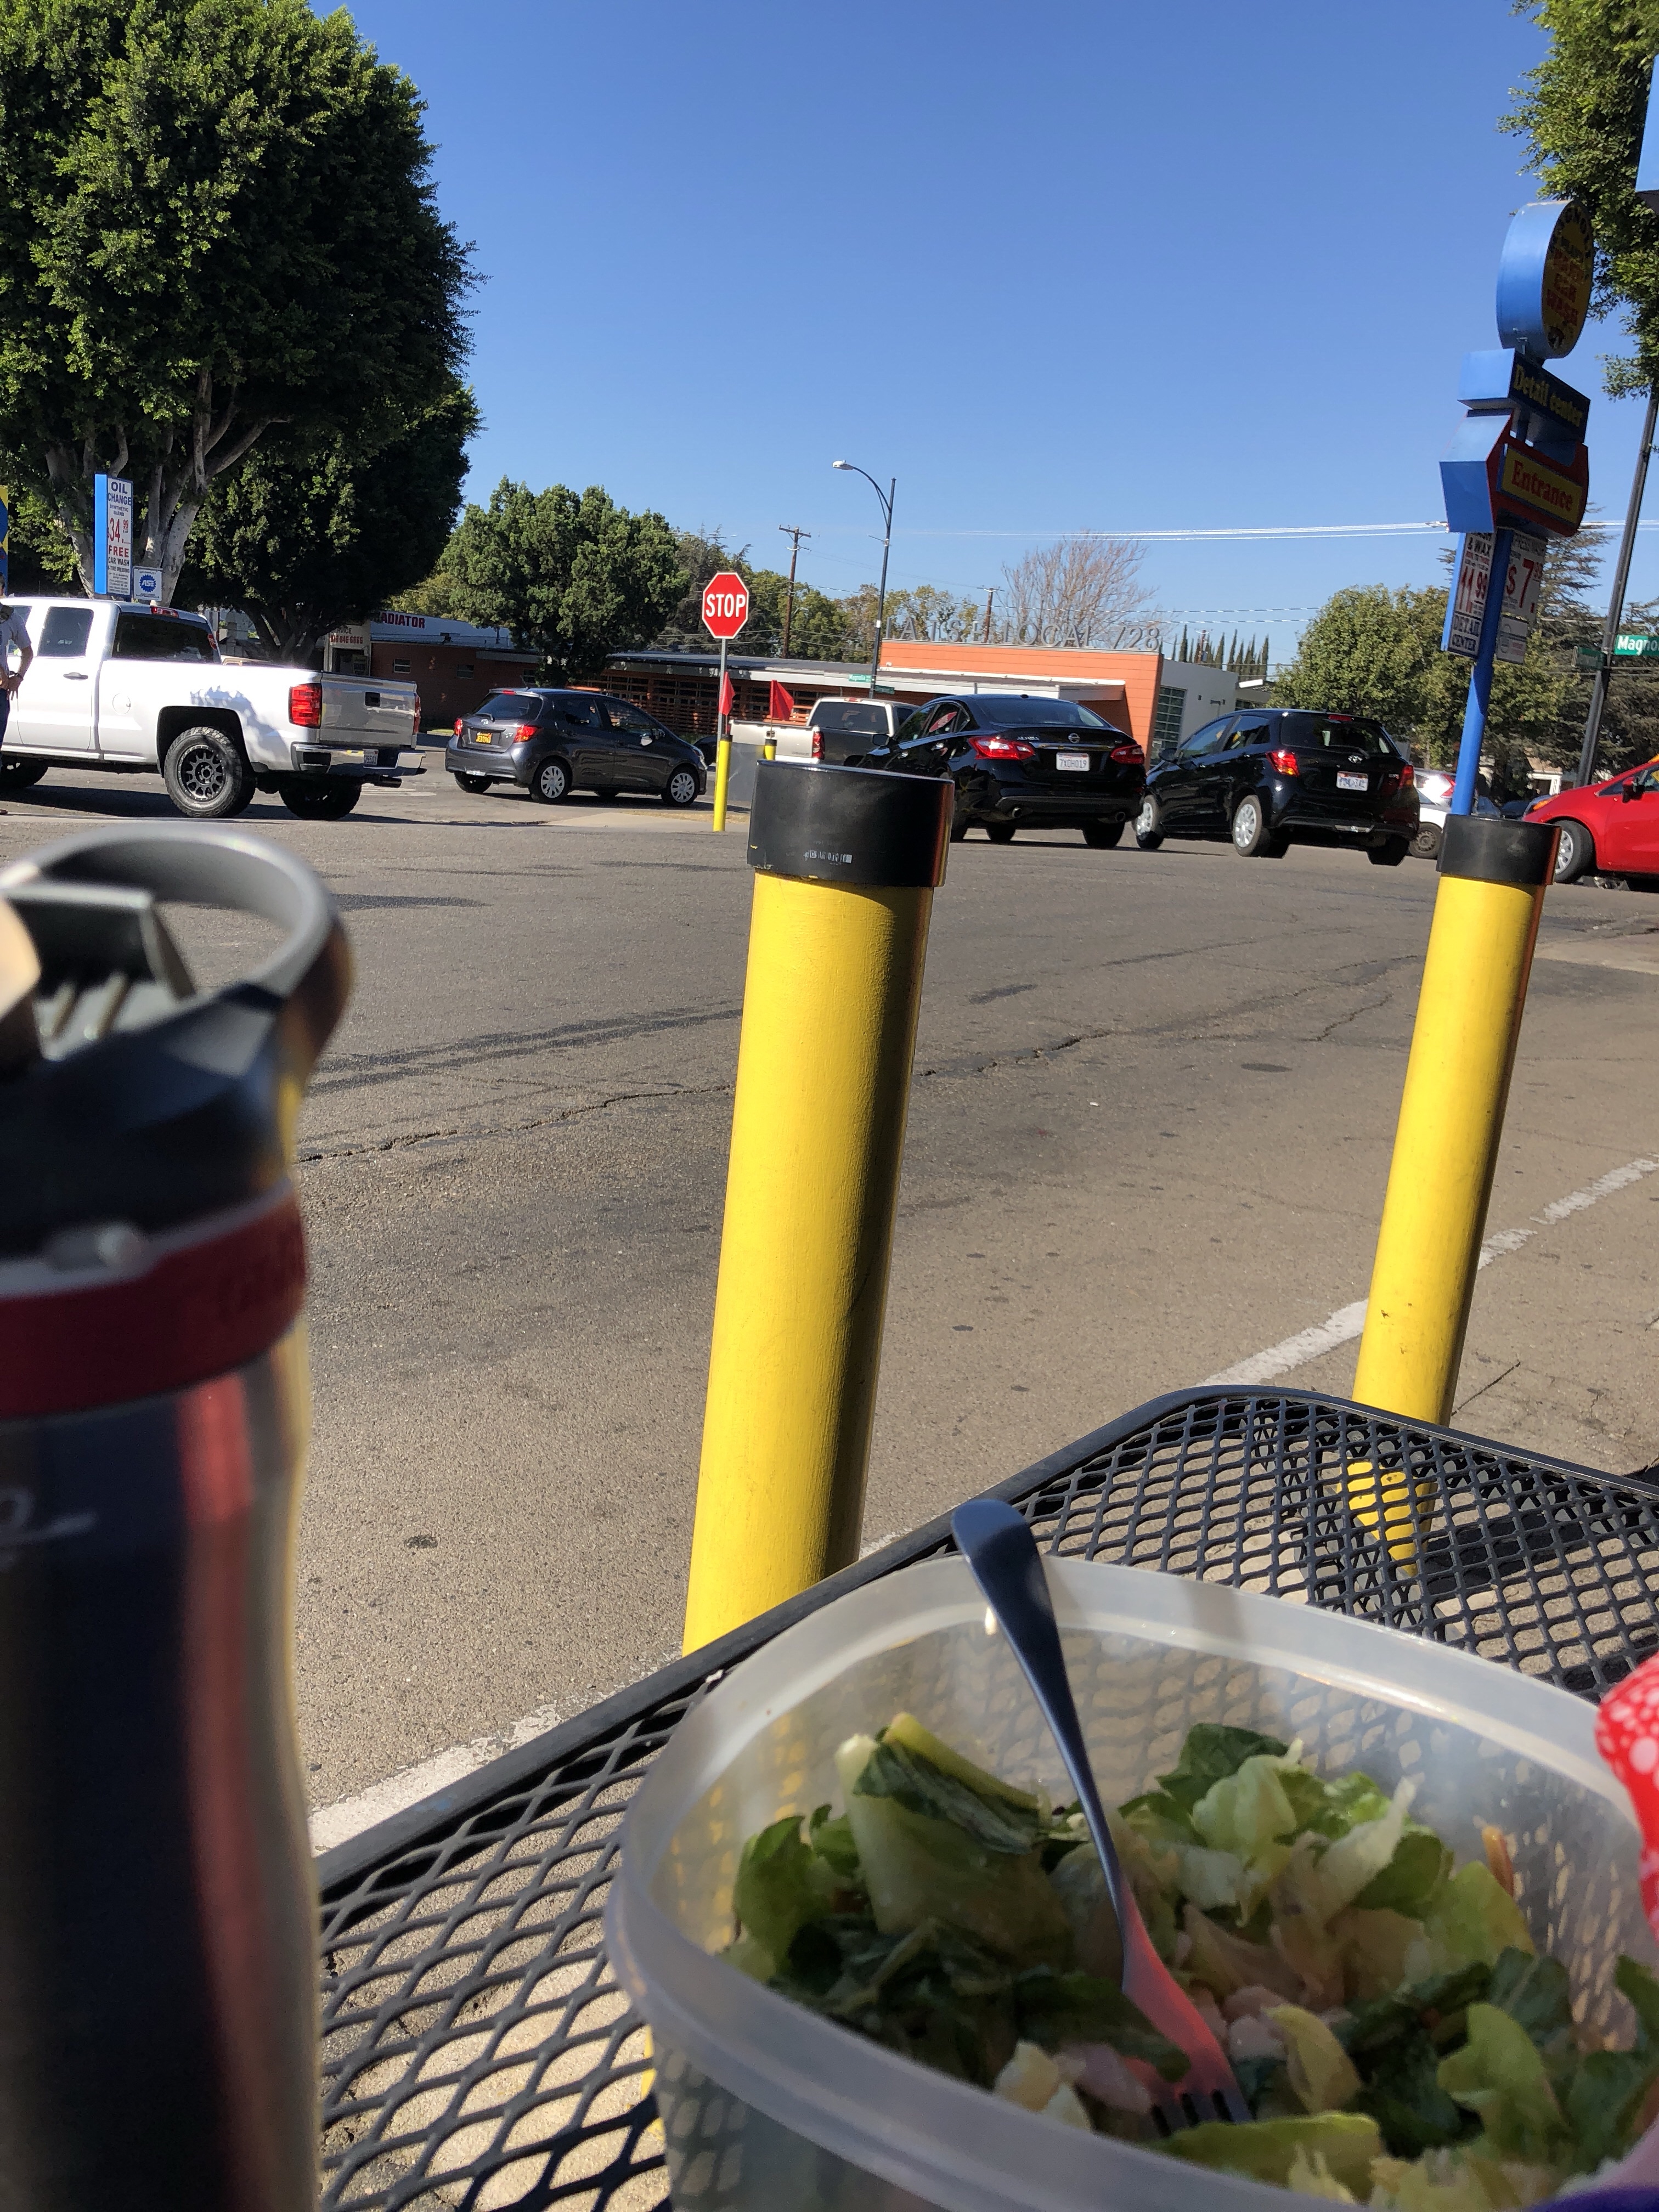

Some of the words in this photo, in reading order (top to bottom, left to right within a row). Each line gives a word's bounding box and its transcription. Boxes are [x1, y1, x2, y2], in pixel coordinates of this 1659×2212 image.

[1514, 364, 1549, 407] Detail
[111, 481, 128, 494] OIL
[1511, 459, 1573, 513] Entrance
[108, 492, 132, 506] CHANGE
[110, 504, 129, 512] SYNTHETIC
[123, 519, 129, 529] 99
[108, 544, 129, 558] FREE
[1474, 539, 1492, 557] WAX
[108, 556, 116, 565] CAR
[117, 558, 129, 567] WASH
[706, 593, 746, 618] STOP
[381, 612, 425, 629] ADIATOR
[1002, 620, 1096, 649] LOCAL
[1113, 624, 1160, 651] 728
